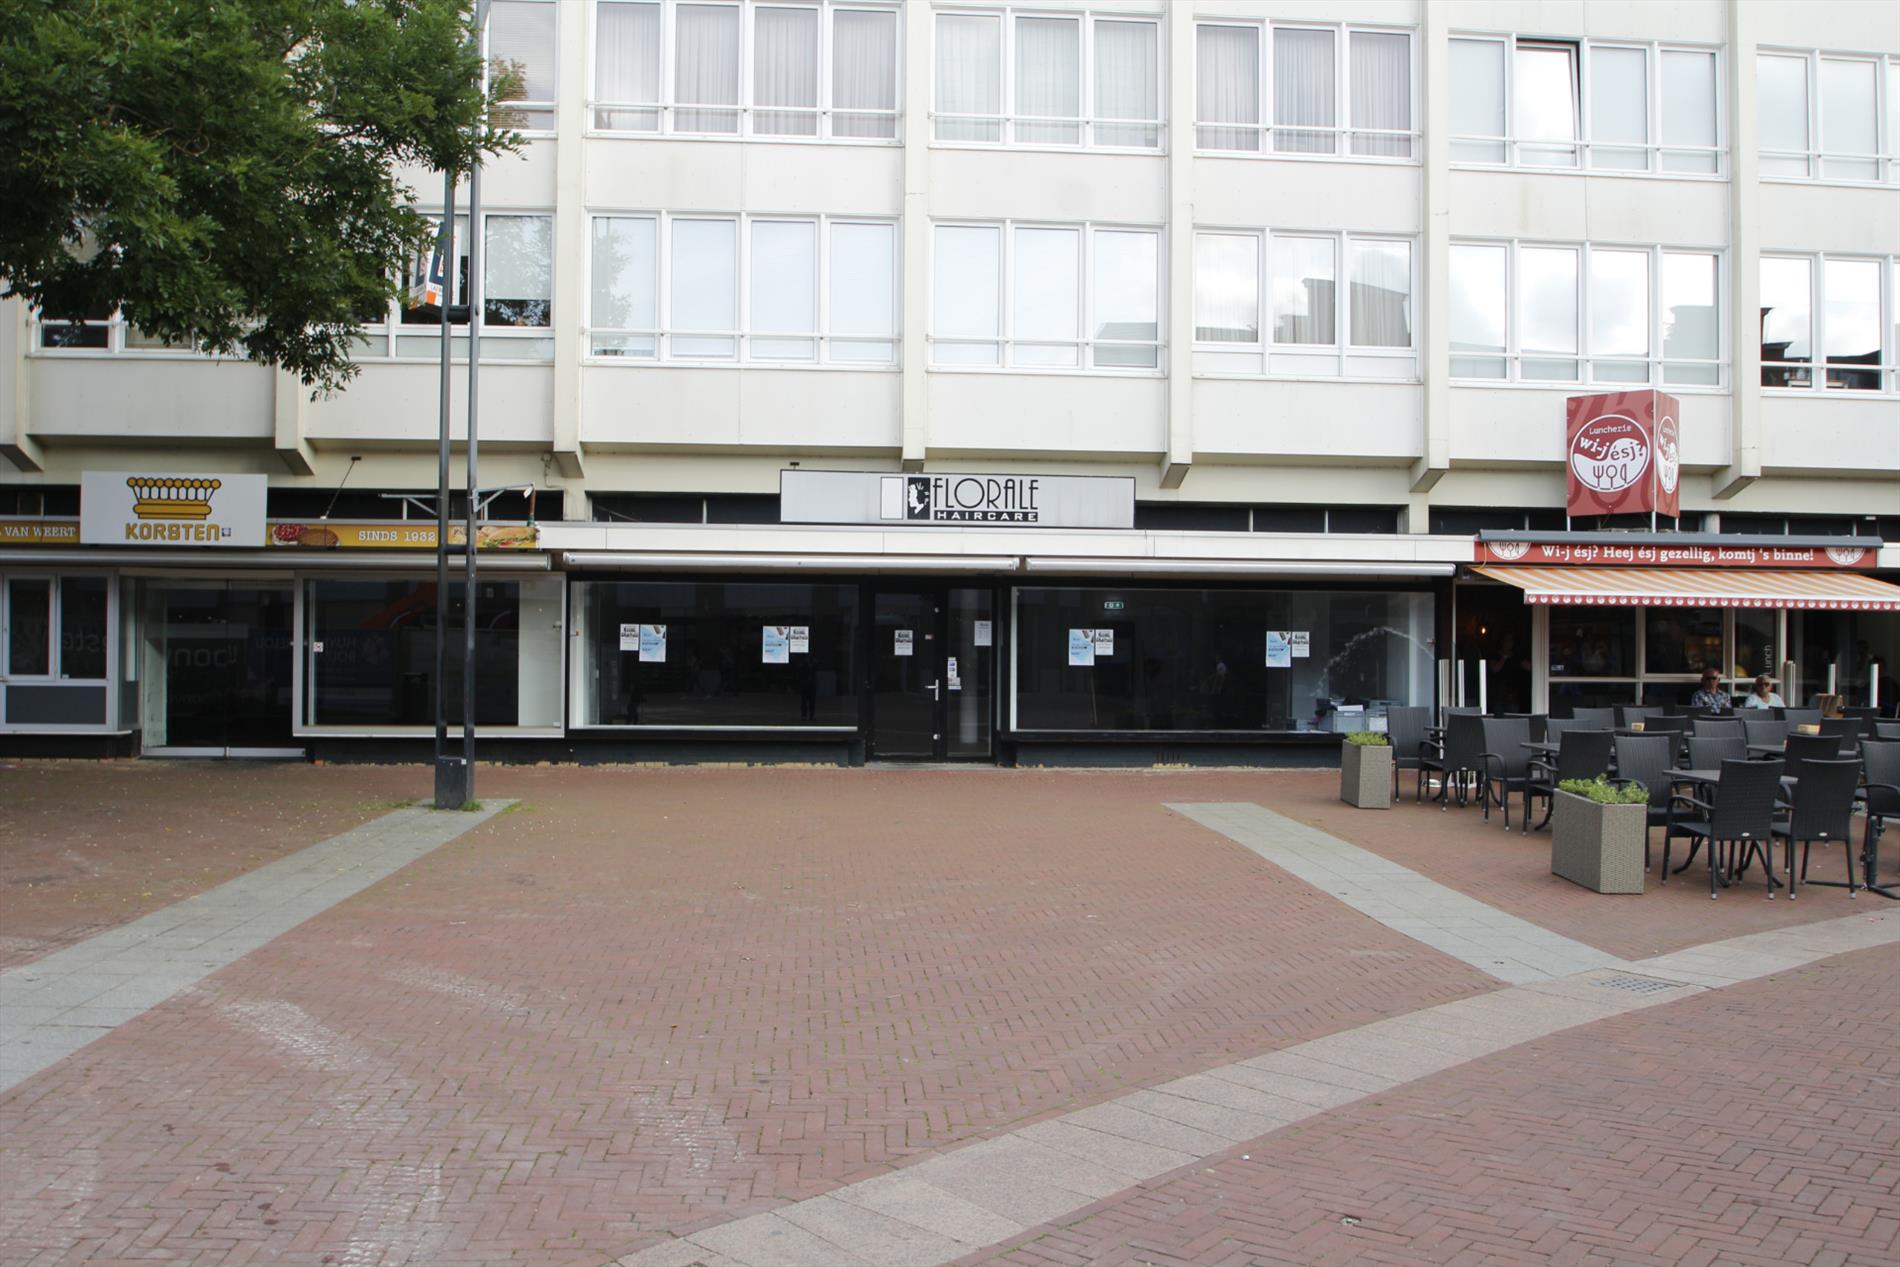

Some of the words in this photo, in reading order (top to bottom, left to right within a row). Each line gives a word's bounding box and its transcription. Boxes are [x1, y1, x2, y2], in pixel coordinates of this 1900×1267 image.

[1589, 424, 1632, 435] Luncherie
[1580, 437, 1610, 460] wi-j
[1610, 442, 1646, 461] ésj?
[932, 477, 1039, 510] FLORALE
[937, 511, 1037, 521] HAIRCARE
[4, 526, 30, 537] VAN
[33, 526, 76, 537] WEERT
[125, 523, 220, 541] KORSTEN
[358, 530, 398, 541] SINDS
[1541, 545, 1570, 561] Wi-j
[1574, 545, 1599, 561] ésj?
[1603, 546, 1634, 562] Heej
[1638, 546, 1656, 562] ésj
[1660, 547, 1715, 563] gezellig,
[1718, 548, 1756, 564] komtj
[1773, 548, 1814, 561] binne!
